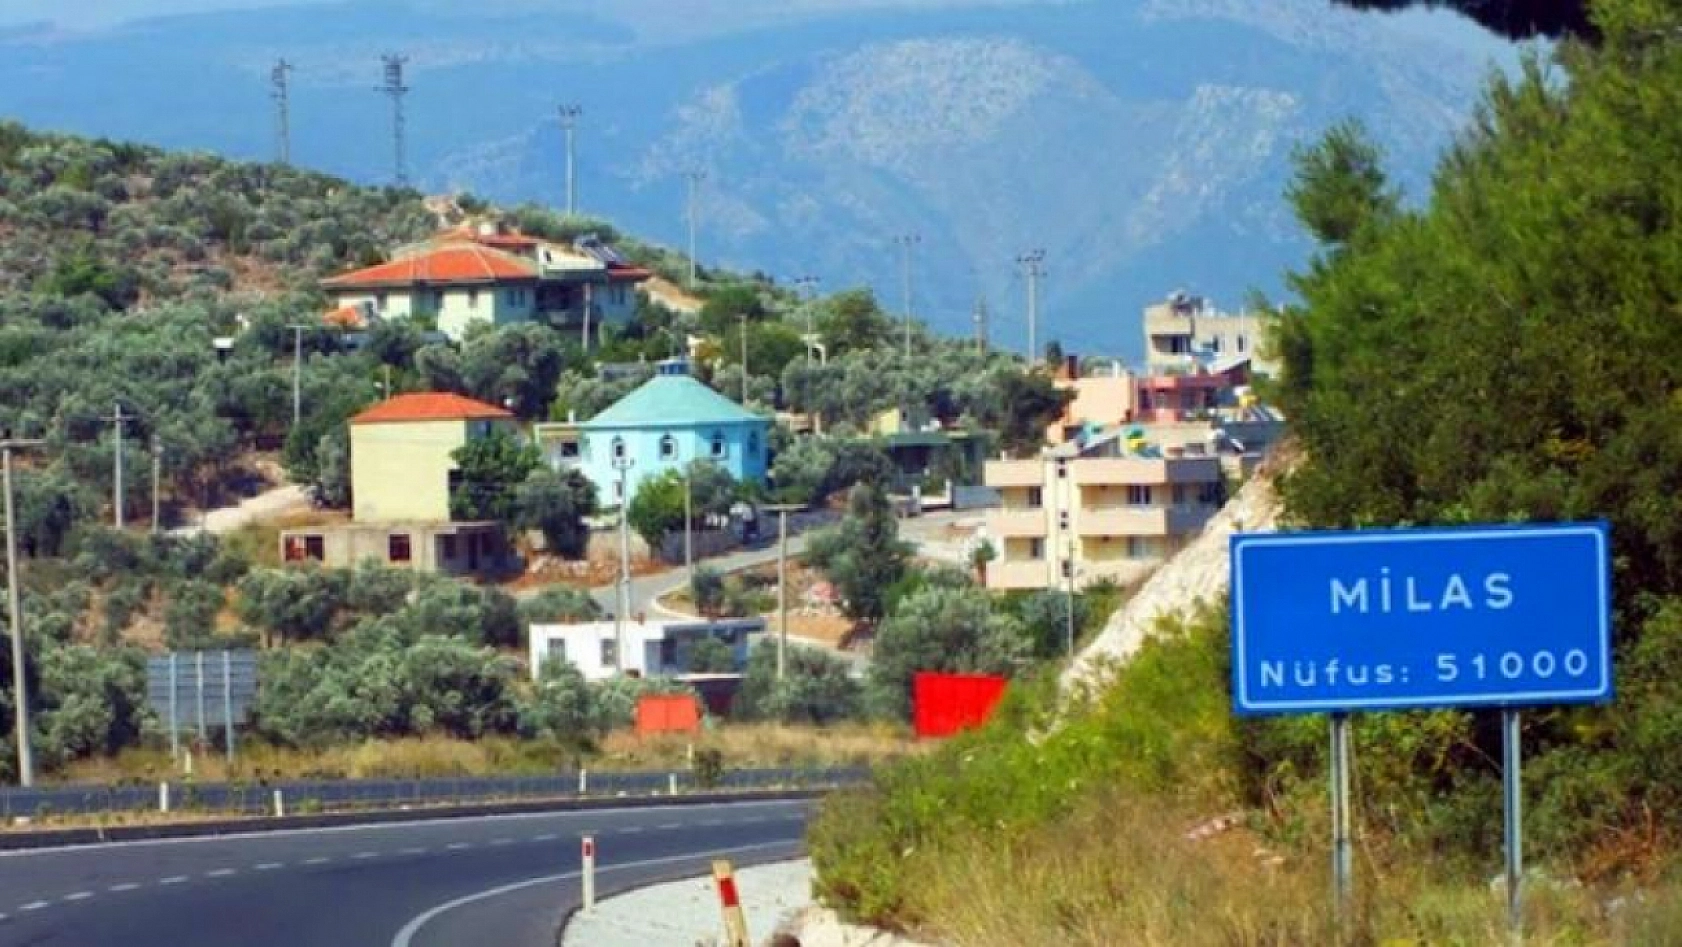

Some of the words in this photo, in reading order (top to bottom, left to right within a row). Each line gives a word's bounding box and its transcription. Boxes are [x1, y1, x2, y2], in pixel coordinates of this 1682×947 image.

[1330, 567, 1514, 613] MİLAS
[1260, 658, 1409, 687] Nüfus:
[1437, 649, 1588, 682] 51000
